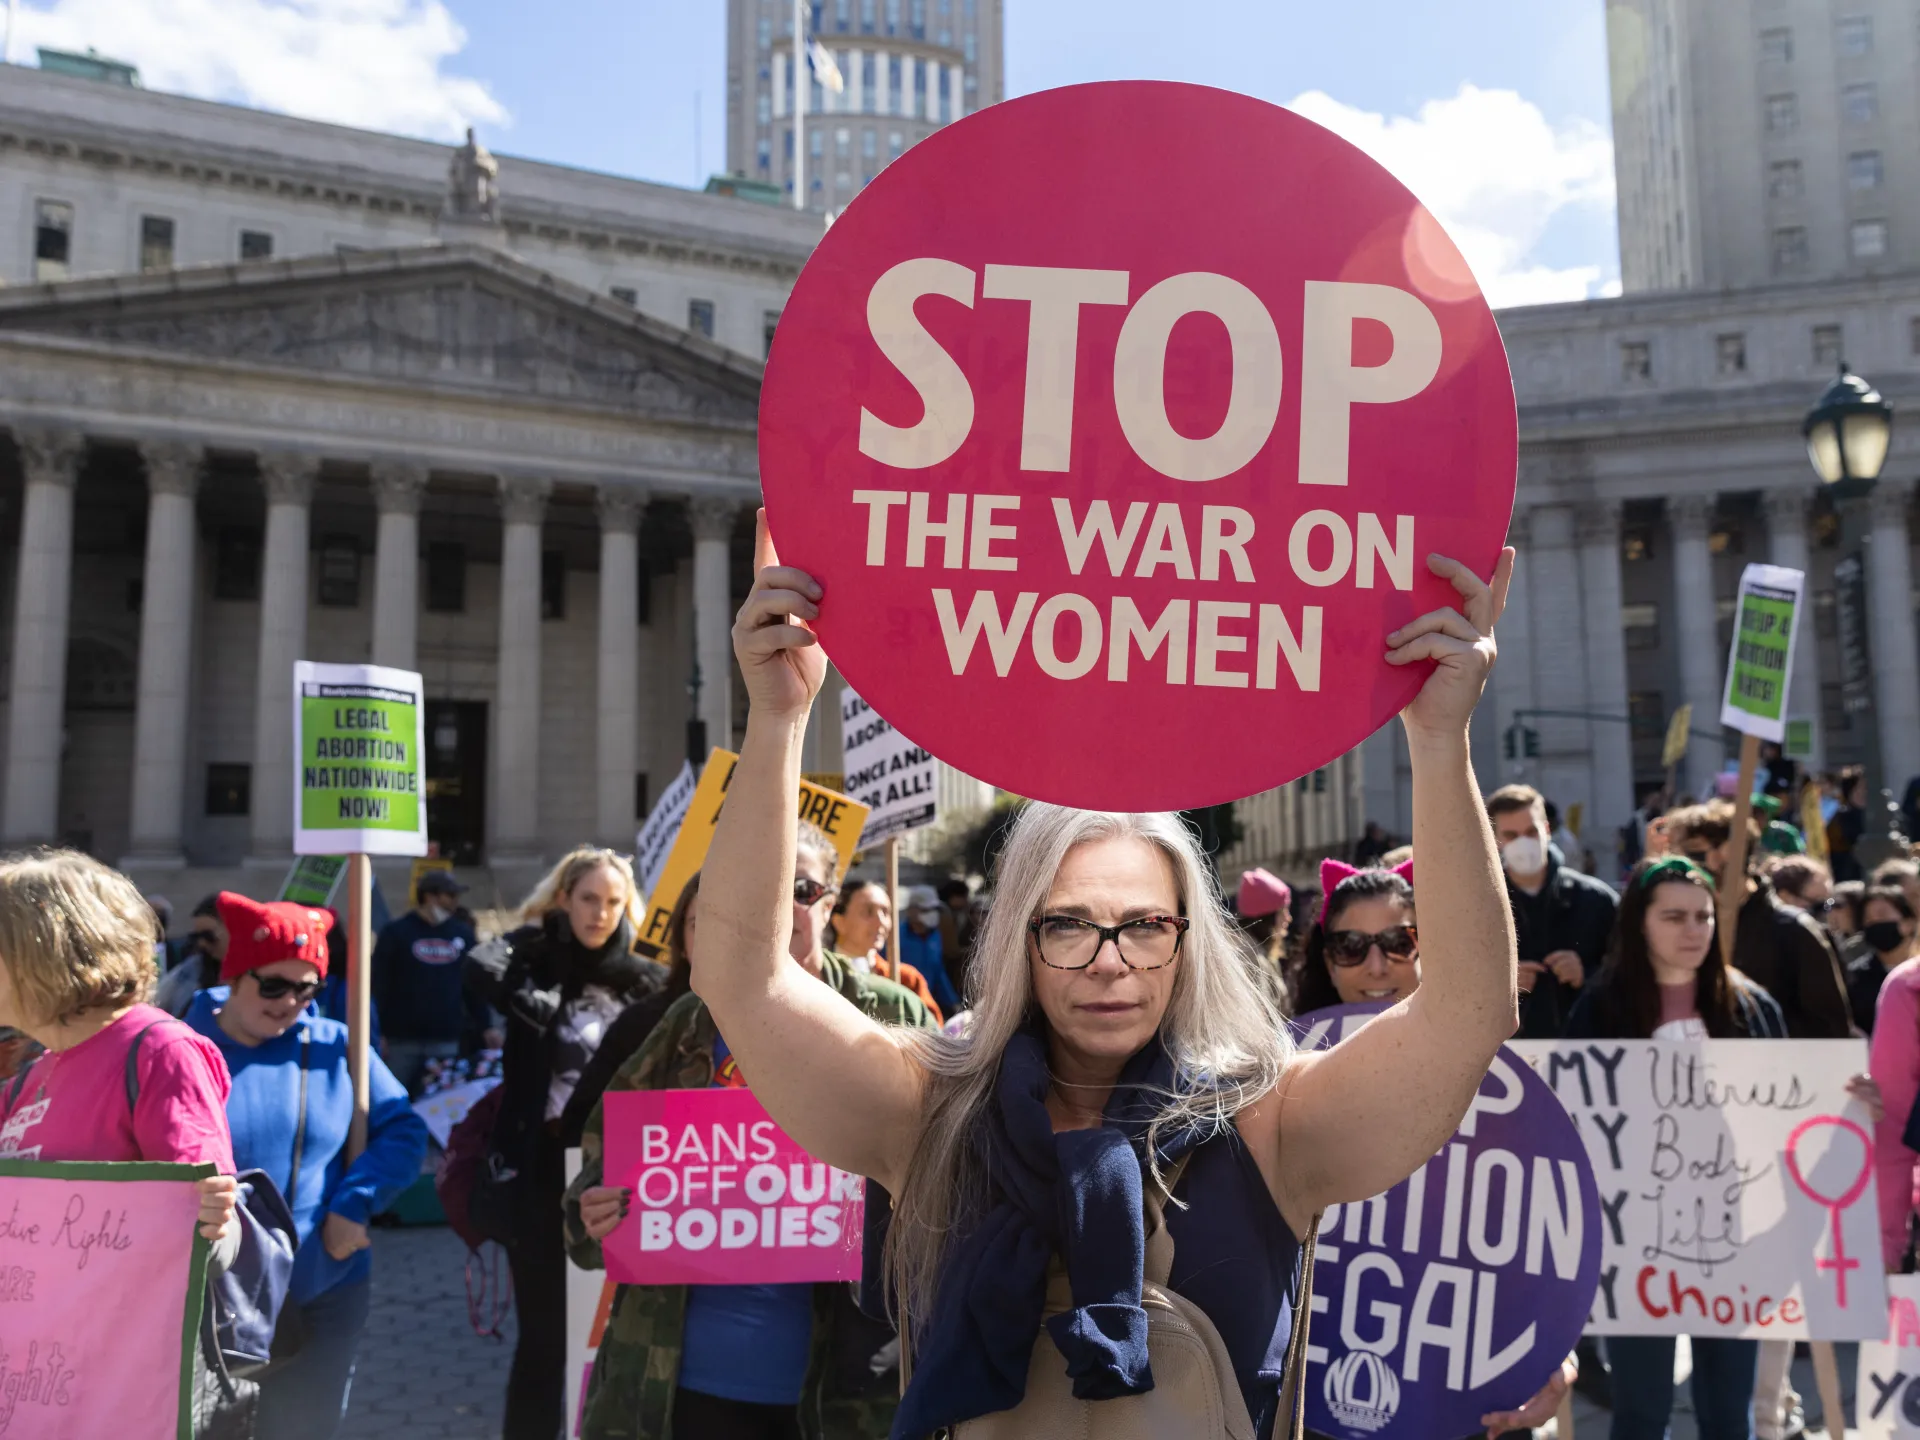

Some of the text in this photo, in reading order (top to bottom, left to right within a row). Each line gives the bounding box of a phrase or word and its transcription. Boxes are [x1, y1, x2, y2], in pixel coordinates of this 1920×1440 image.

[858, 257, 1443, 486] STOP
[853, 490, 1415, 591] THE WAR ON
[932, 589, 1323, 692] WOMEN
[334, 708, 391, 731] LEGAL
[846, 718, 892, 750] ABOR
[316, 737, 407, 762] ABORTION
[844, 759, 886, 792] ONCE
[890, 748, 933, 774] AND
[304, 766, 418, 793] NATIONWIDE
[859, 771, 933, 811] OR ALL!
[339, 796, 389, 820] NOW!
[1550, 1045, 1627, 1107] MY
[1646, 1046, 1818, 1111] Uterus
[642, 1121, 776, 1164] BANS
[1571, 1113, 1775, 1206] Y Body
[638, 1163, 865, 1208] OFF OUR
[52, 1193, 133, 1271] Rights
[640, 1205, 842, 1251] BODIES
[1601, 1184, 1752, 1279] Y Life
[1586, 1264, 1803, 1327] Y Choice
[1324, 1351, 1400, 1415] NOW
